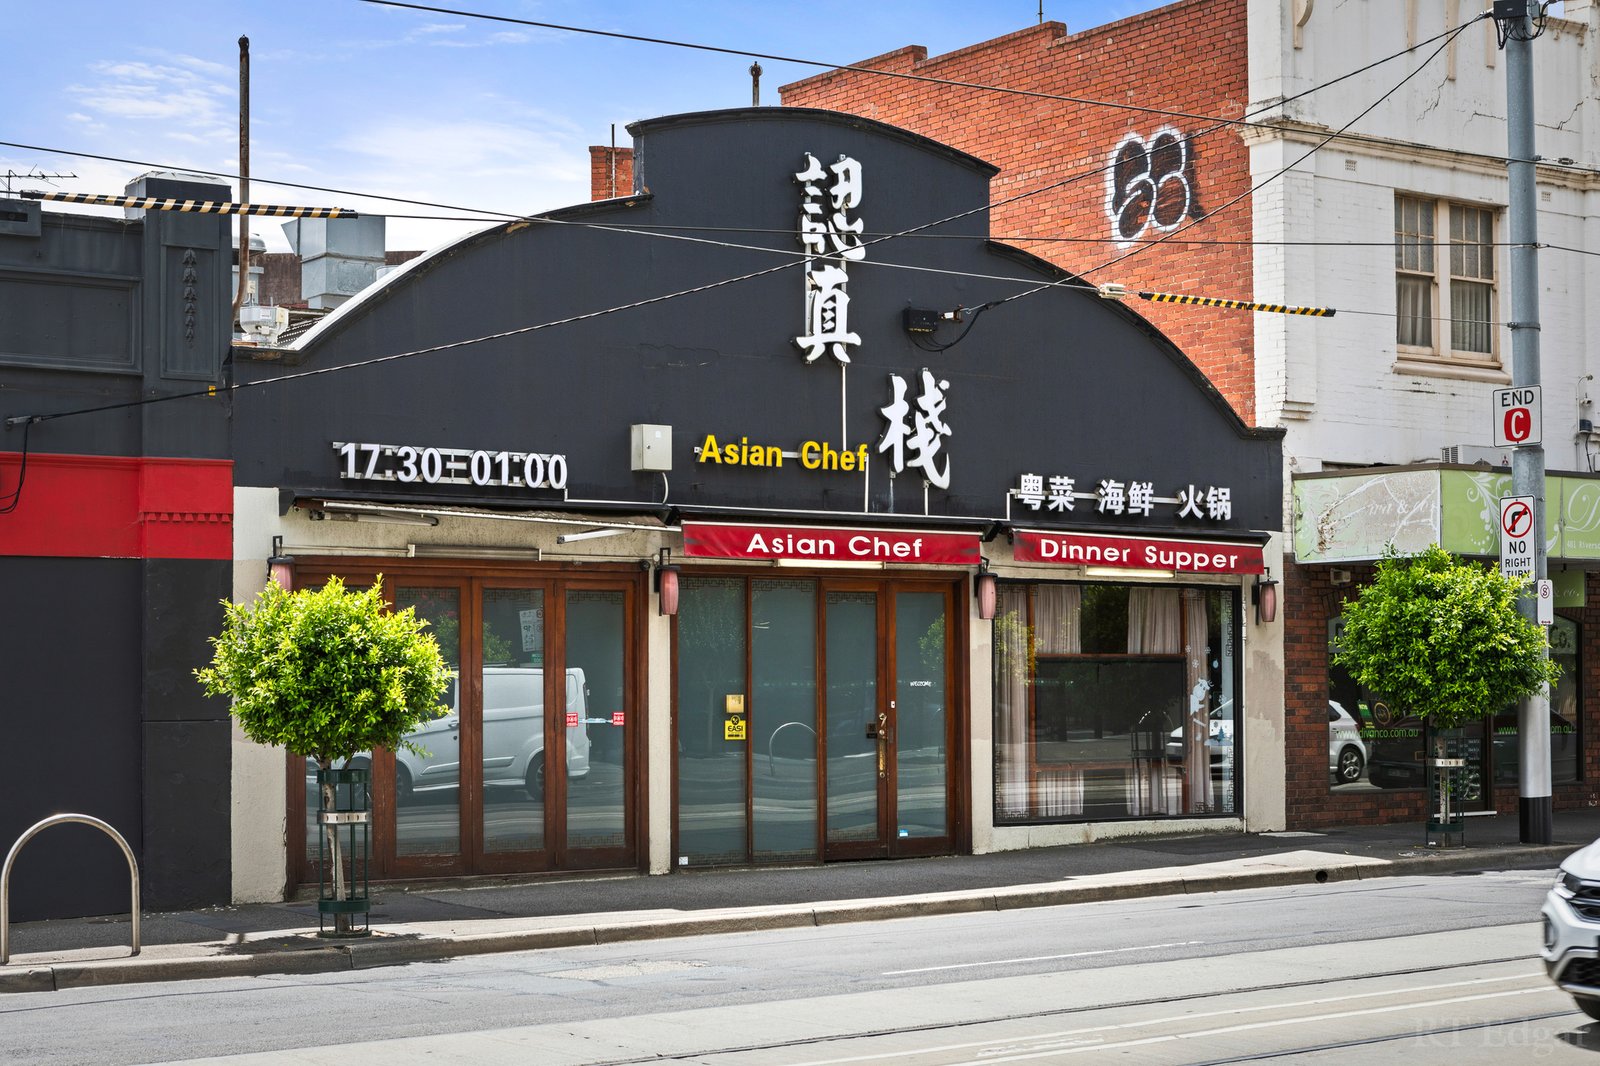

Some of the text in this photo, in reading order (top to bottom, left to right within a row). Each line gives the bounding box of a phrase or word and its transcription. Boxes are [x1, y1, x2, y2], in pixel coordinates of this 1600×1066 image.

[1501, 390, 1534, 407] END
[1511, 411, 1524, 439] C
[699, 434, 867, 472] Asian Chef
[1018, 473, 1231, 520] 粤菜 海鲜 火锅
[747, 533, 923, 557] Asian Chef
[1040, 539, 1238, 570] Dinner Supper
[1509, 541, 1526, 554] NO
[1505, 557, 1531, 568] RIGHT
